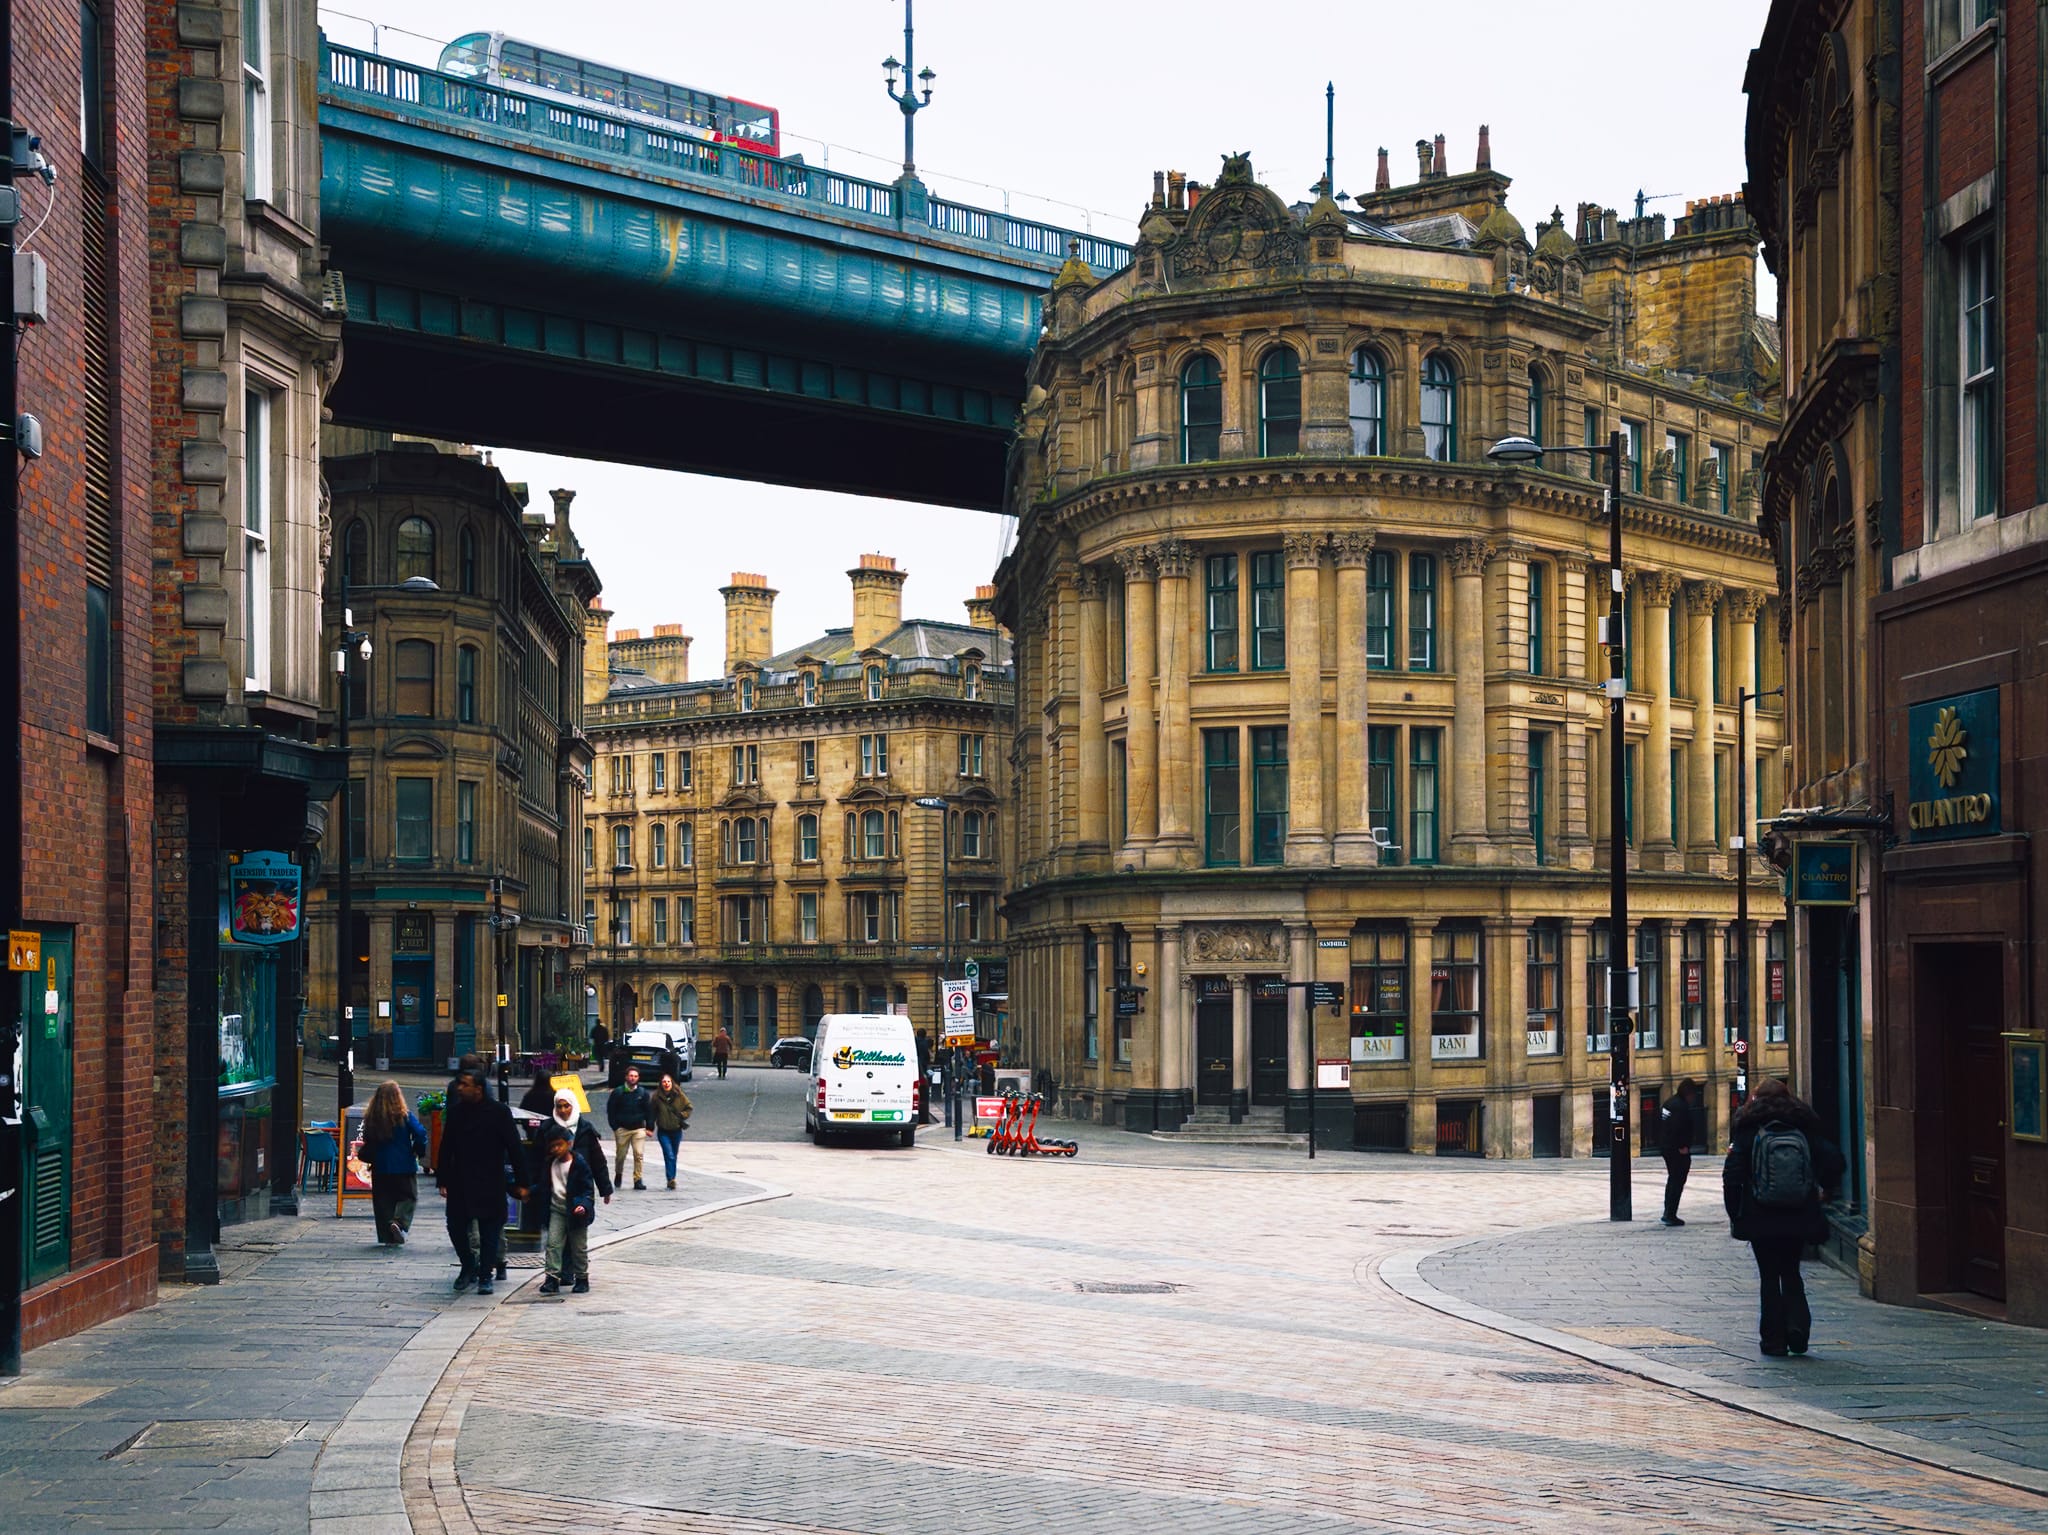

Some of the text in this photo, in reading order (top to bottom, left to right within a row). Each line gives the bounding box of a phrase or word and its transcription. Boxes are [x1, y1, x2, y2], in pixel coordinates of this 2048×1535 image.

[1909, 793, 1990, 829] CILANTRO
[269, 867, 298, 876] TRADERS
[1801, 872, 1847, 881] CILANTRO
[499, 995, 506, 1005] H
[1363, 1039, 1392, 1052] RANI
[1439, 1037, 1466, 1049] RANI
[852, 1049, 906, 1063] Hillheads
